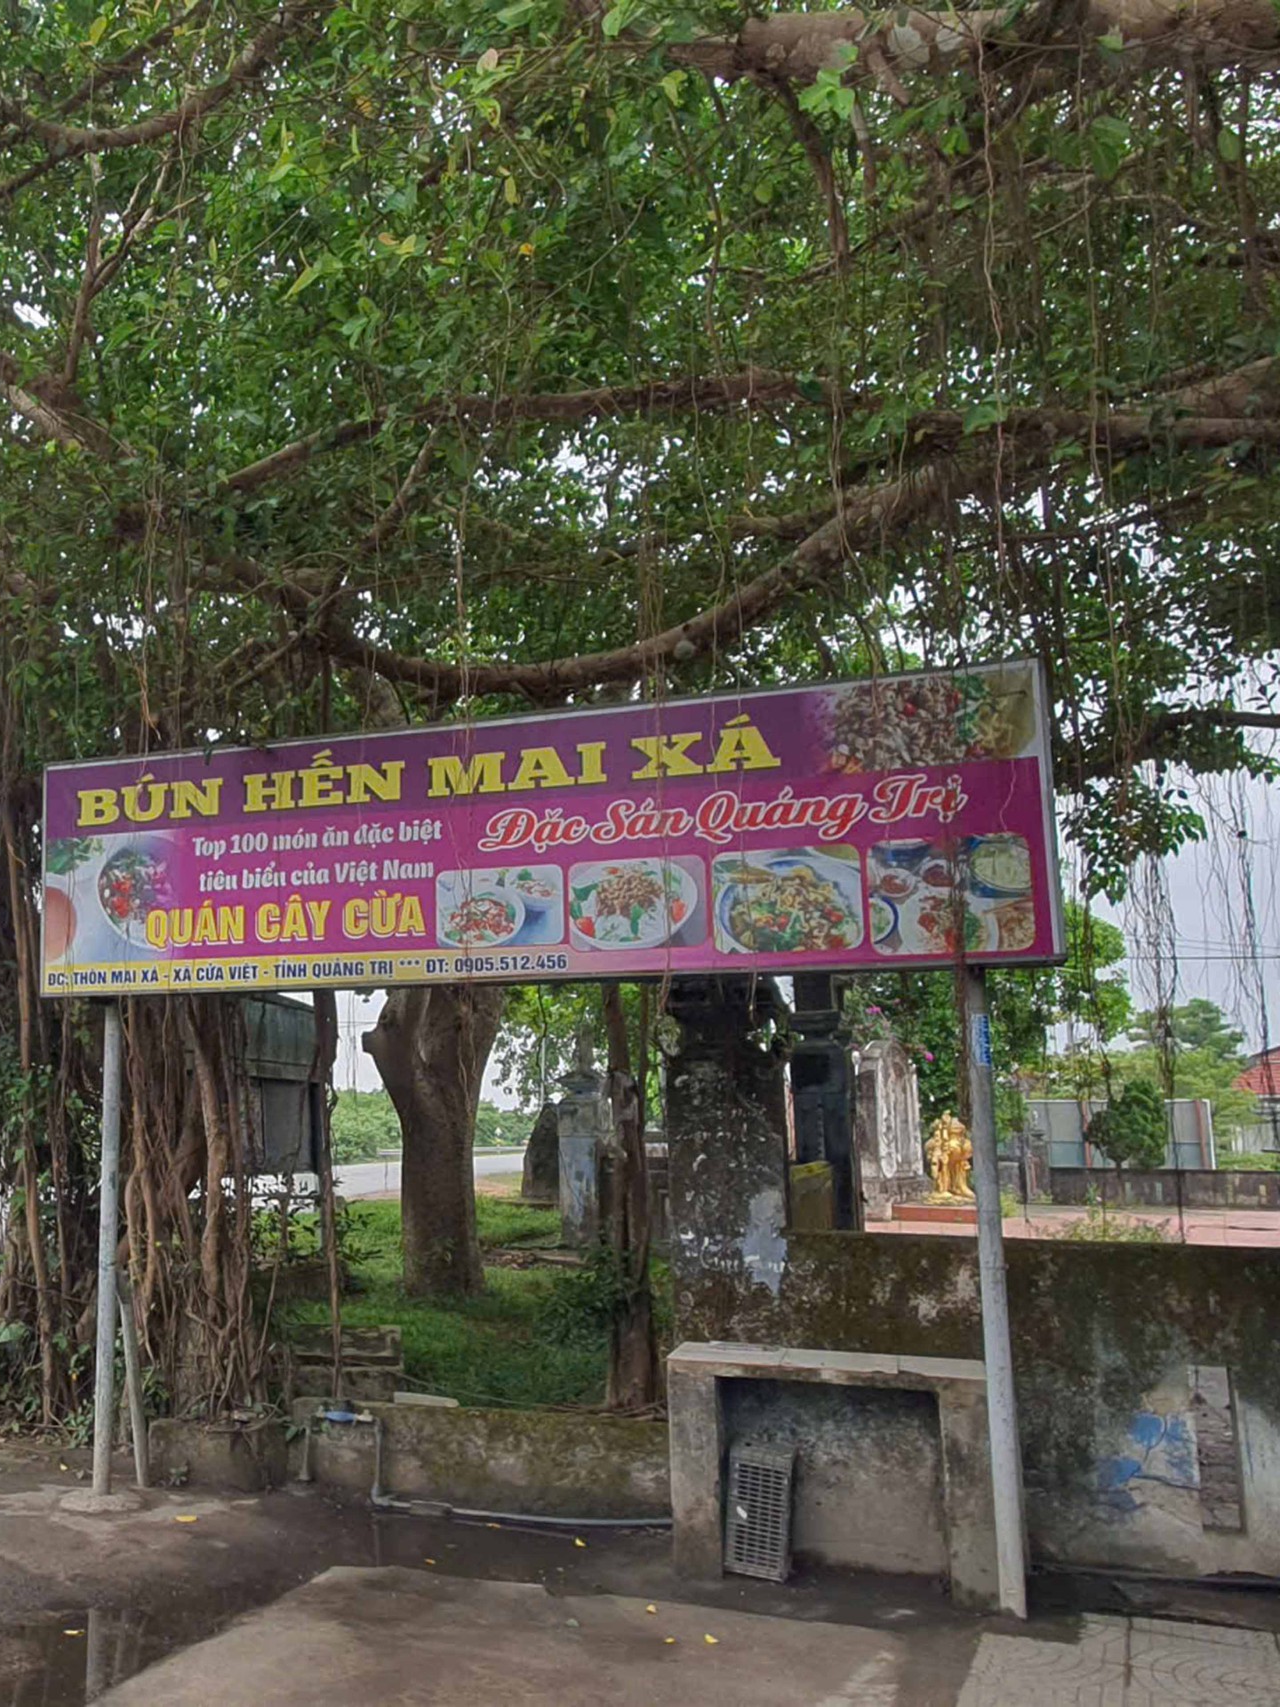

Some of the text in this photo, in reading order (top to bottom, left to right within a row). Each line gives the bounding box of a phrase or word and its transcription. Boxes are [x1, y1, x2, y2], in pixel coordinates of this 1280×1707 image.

[76, 713, 782, 827] BÚN HẾN MAI XÁ
[477, 772, 969, 853] Đặc Sản Quảng Trị
[192, 818, 443, 861] Top 100 món ăn đặc biệt
[199, 859, 434, 892] tiêu biểu của Việt Nam
[145, 888, 426, 951] QUÁN CÂY CỪA
[73, 968, 107, 985] THÔN
[111, 970, 136, 984] MAI
[196, 963, 224, 981] CỬA
[229, 963, 258, 984] VIỆT
[274, 960, 308, 979] TỈNH
[312, 958, 364, 978] QUẢNG
[370, 960, 393, 978] TRỊ
[426, 958, 449, 974] ĐT:
[454, 954, 567, 973] 0905.512.456
